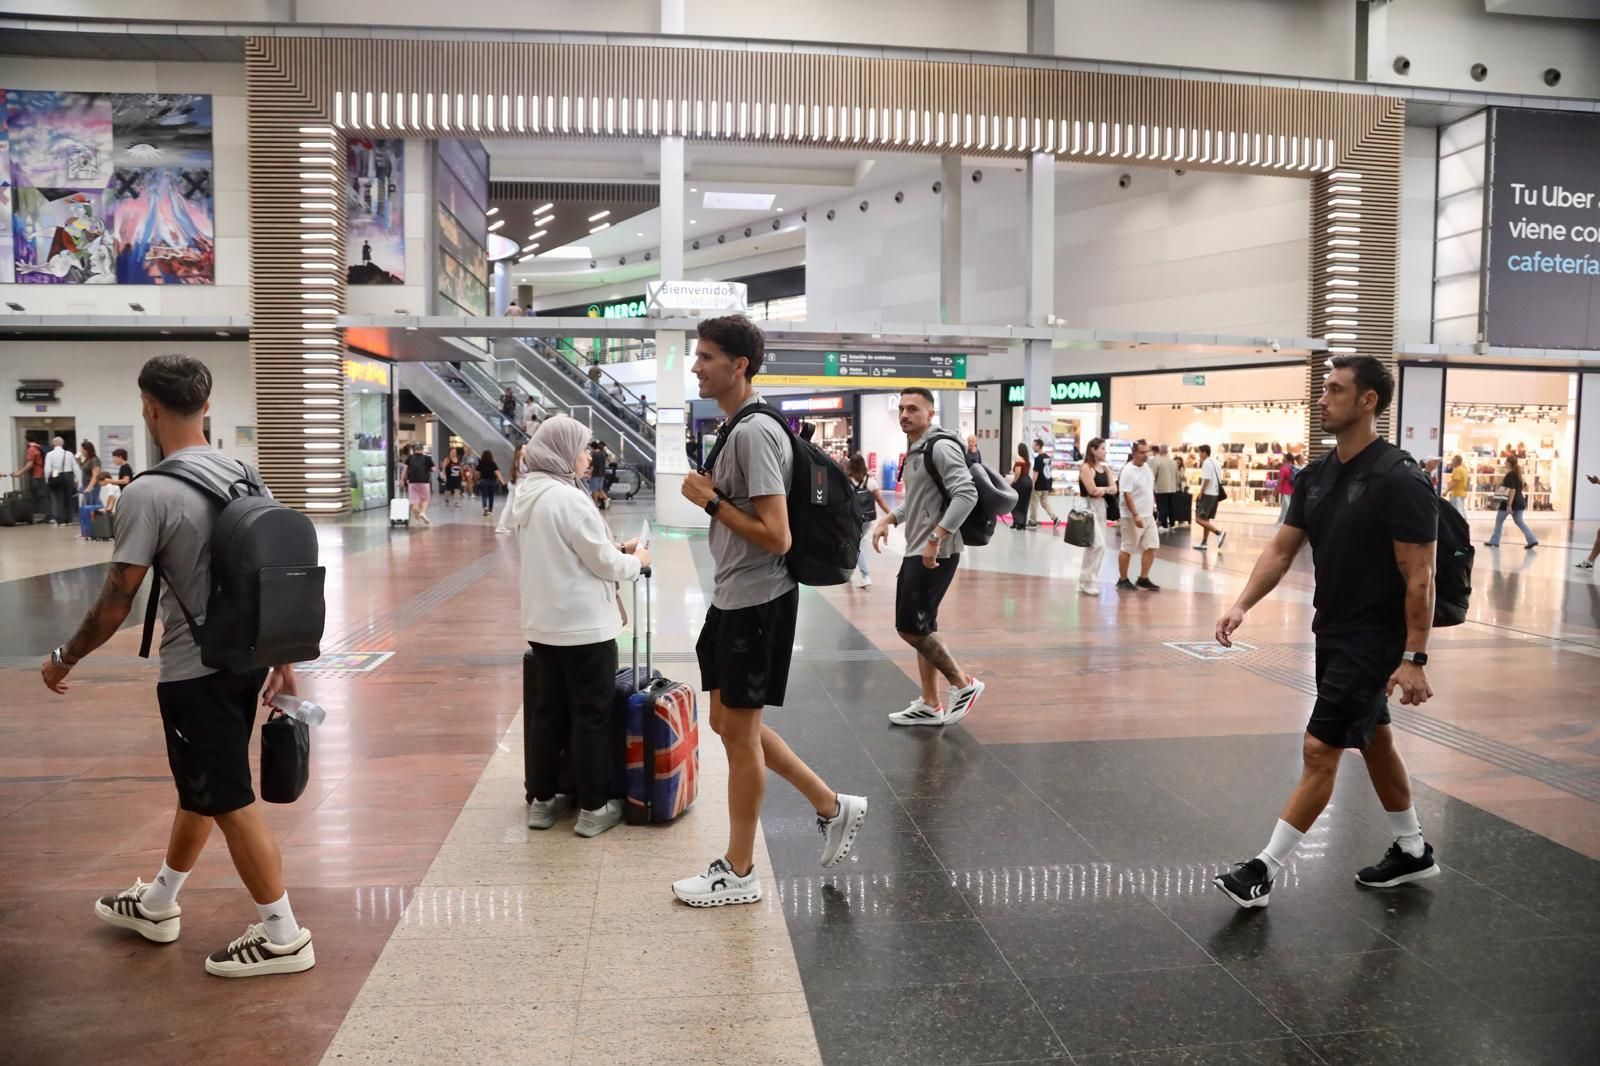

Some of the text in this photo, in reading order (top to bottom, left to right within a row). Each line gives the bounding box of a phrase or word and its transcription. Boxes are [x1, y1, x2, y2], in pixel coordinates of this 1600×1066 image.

[1510, 183, 1595, 209] Tu Uber
[1509, 217, 1600, 243] viene co
[1507, 251, 1600, 275] cafetería
[662, 285, 736, 296] Bienvenidos
[1009, 381, 1101, 402] MADONA
